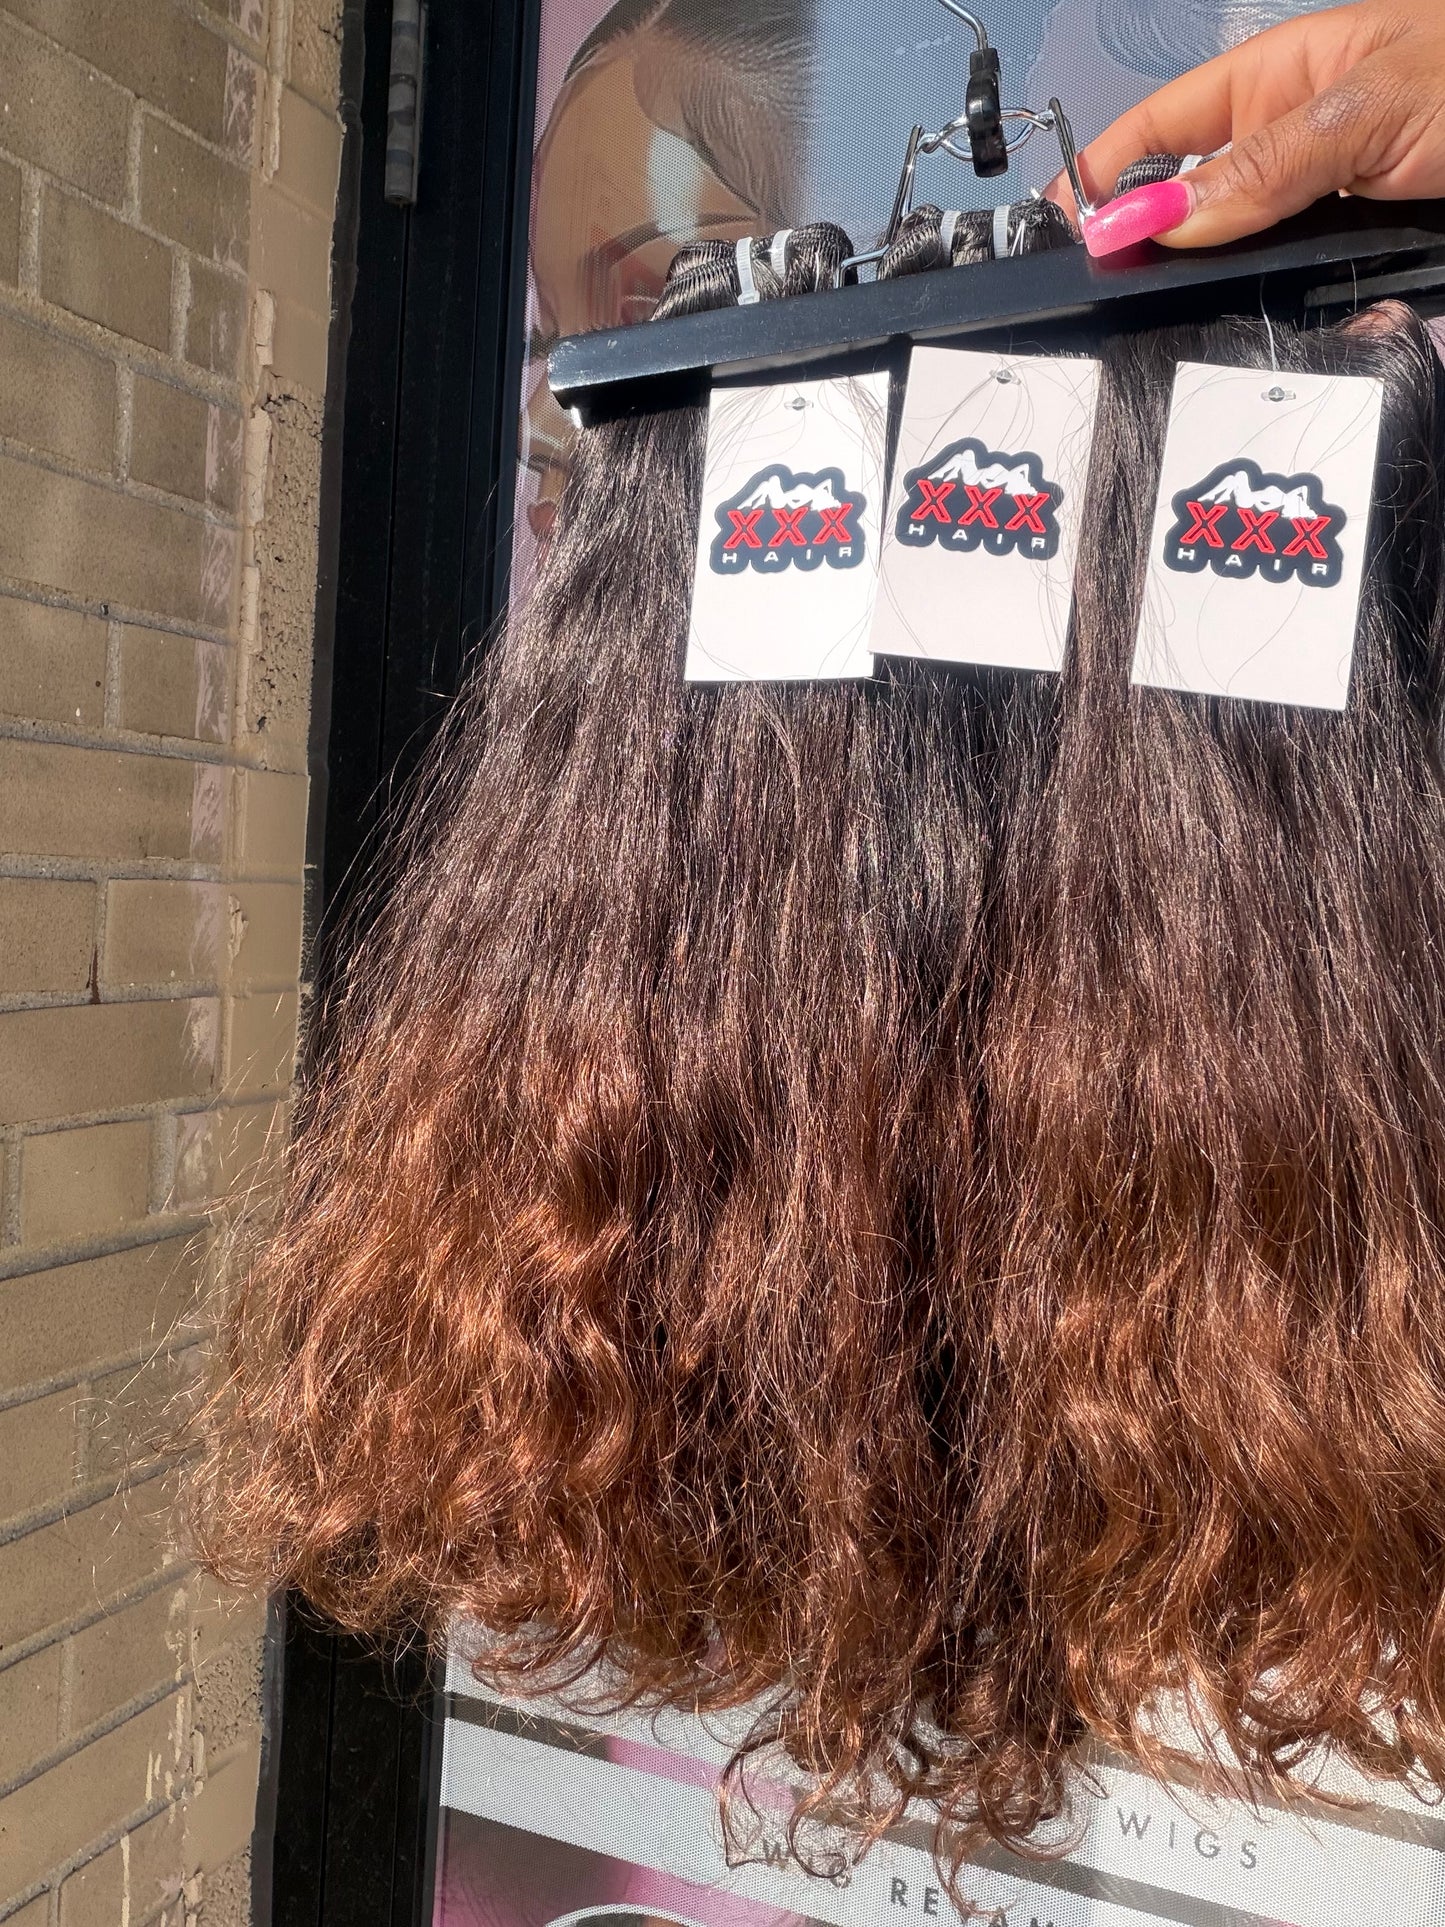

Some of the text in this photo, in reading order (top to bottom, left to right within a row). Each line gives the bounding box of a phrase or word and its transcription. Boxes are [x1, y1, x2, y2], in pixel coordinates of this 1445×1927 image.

[725, 503, 852, 548] XXX
[911, 480, 1050, 533] XXX
[908, 523, 1046, 549] HAIR
[1180, 501, 1331, 559] XXX
[721, 547, 853, 564] HAIR
[1177, 547, 1329, 576] HAIR
[1116, 1806, 1258, 1869] WIGS
